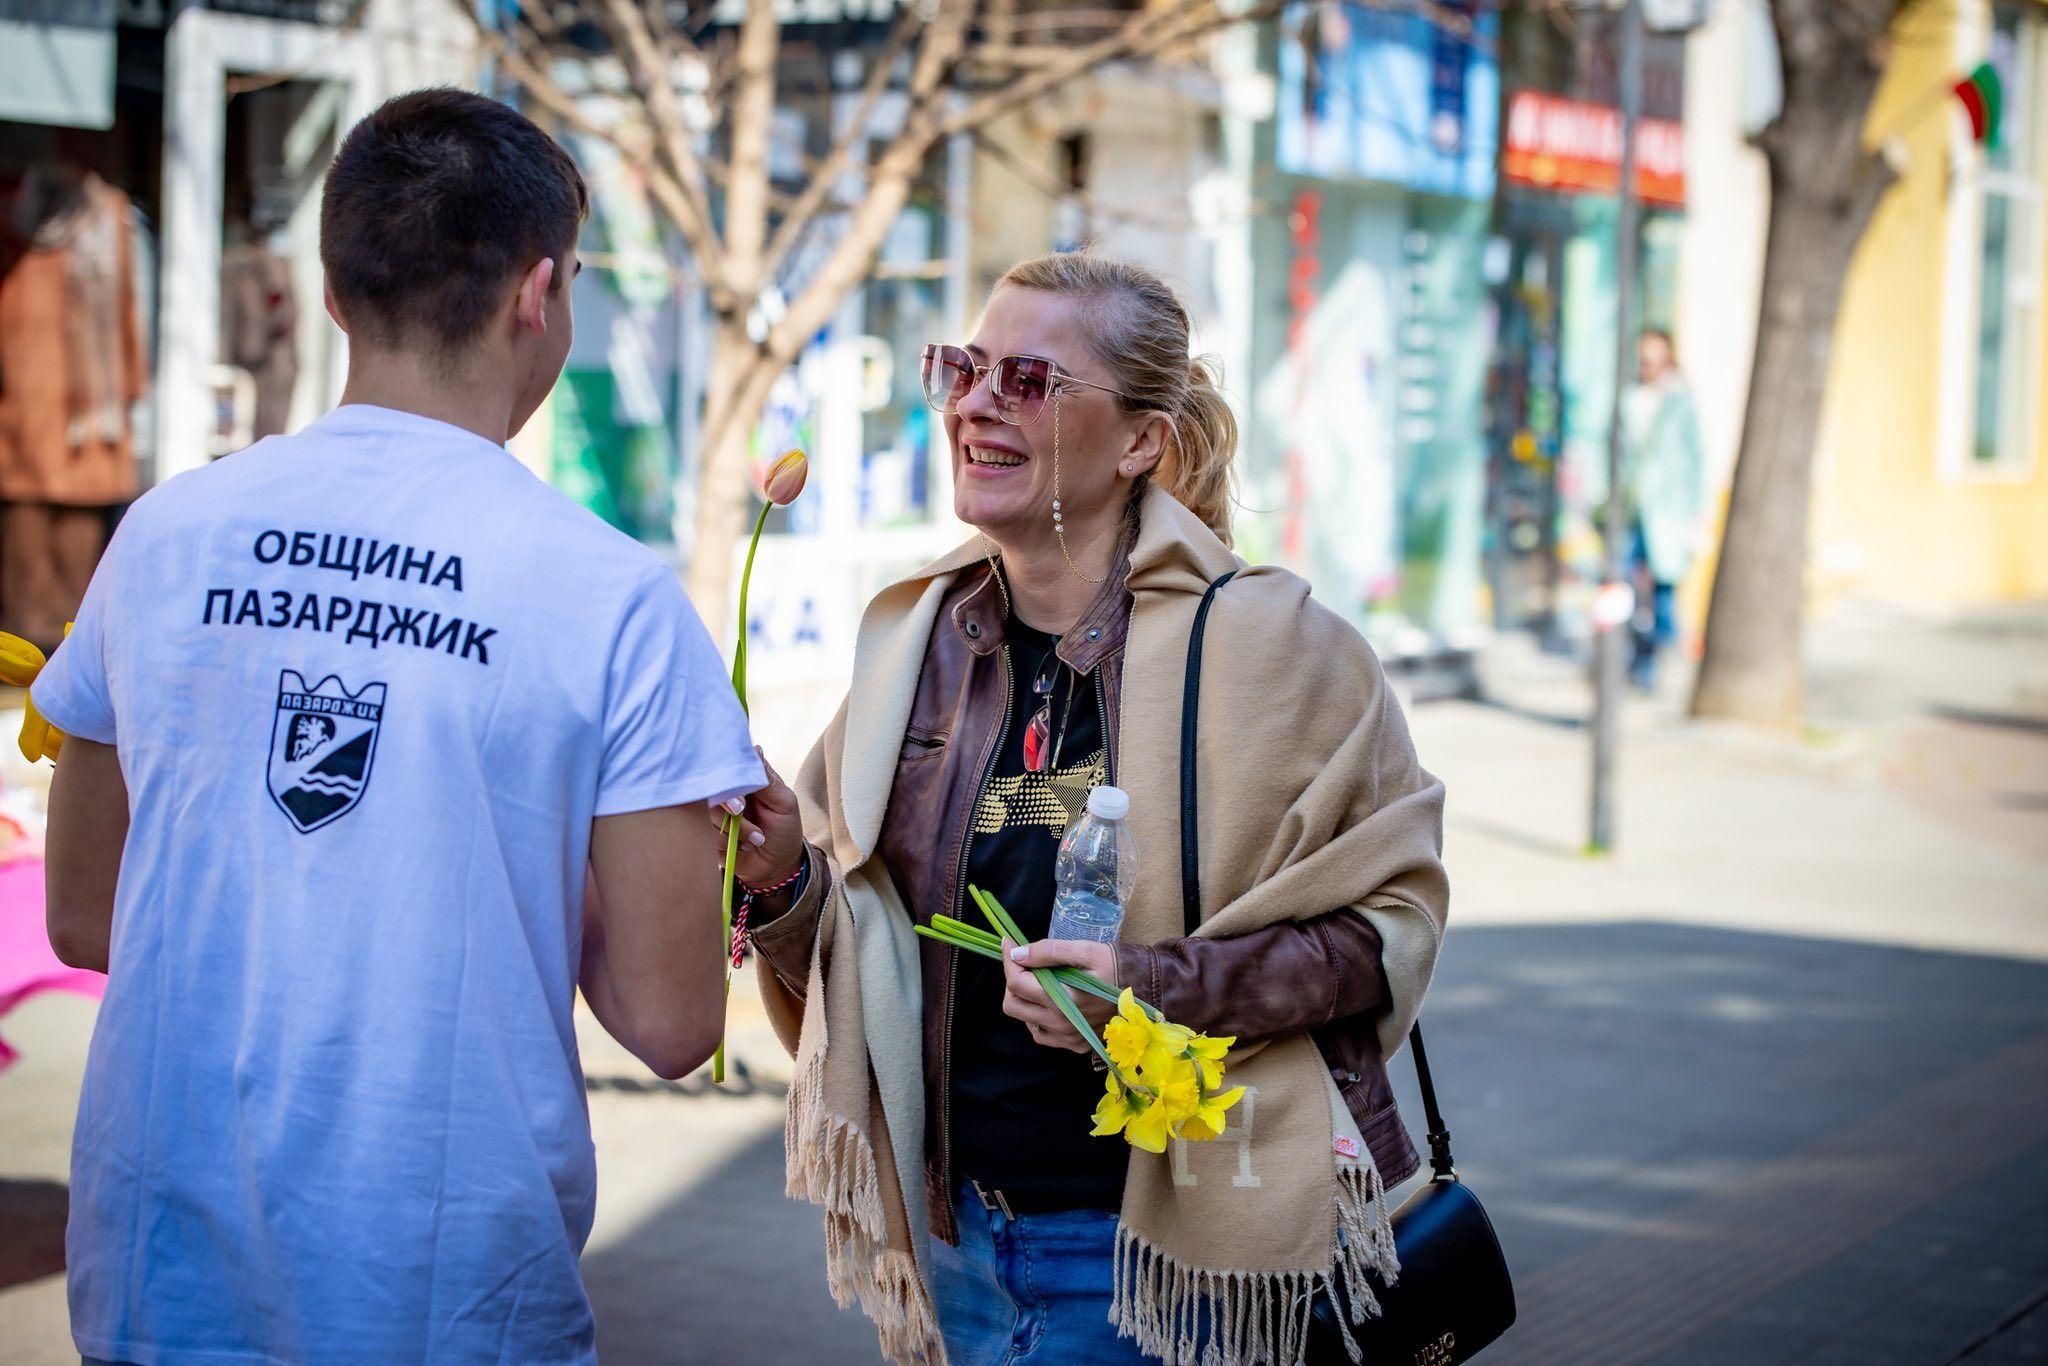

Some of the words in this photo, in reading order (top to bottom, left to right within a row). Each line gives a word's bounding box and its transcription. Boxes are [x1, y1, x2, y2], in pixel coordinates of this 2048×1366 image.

[253, 529, 463, 592] ОБЩИНА
[202, 588, 498, 665] ПАЗАРДЖИК
[280, 694, 380, 720] ПАЗАРДЖИК
